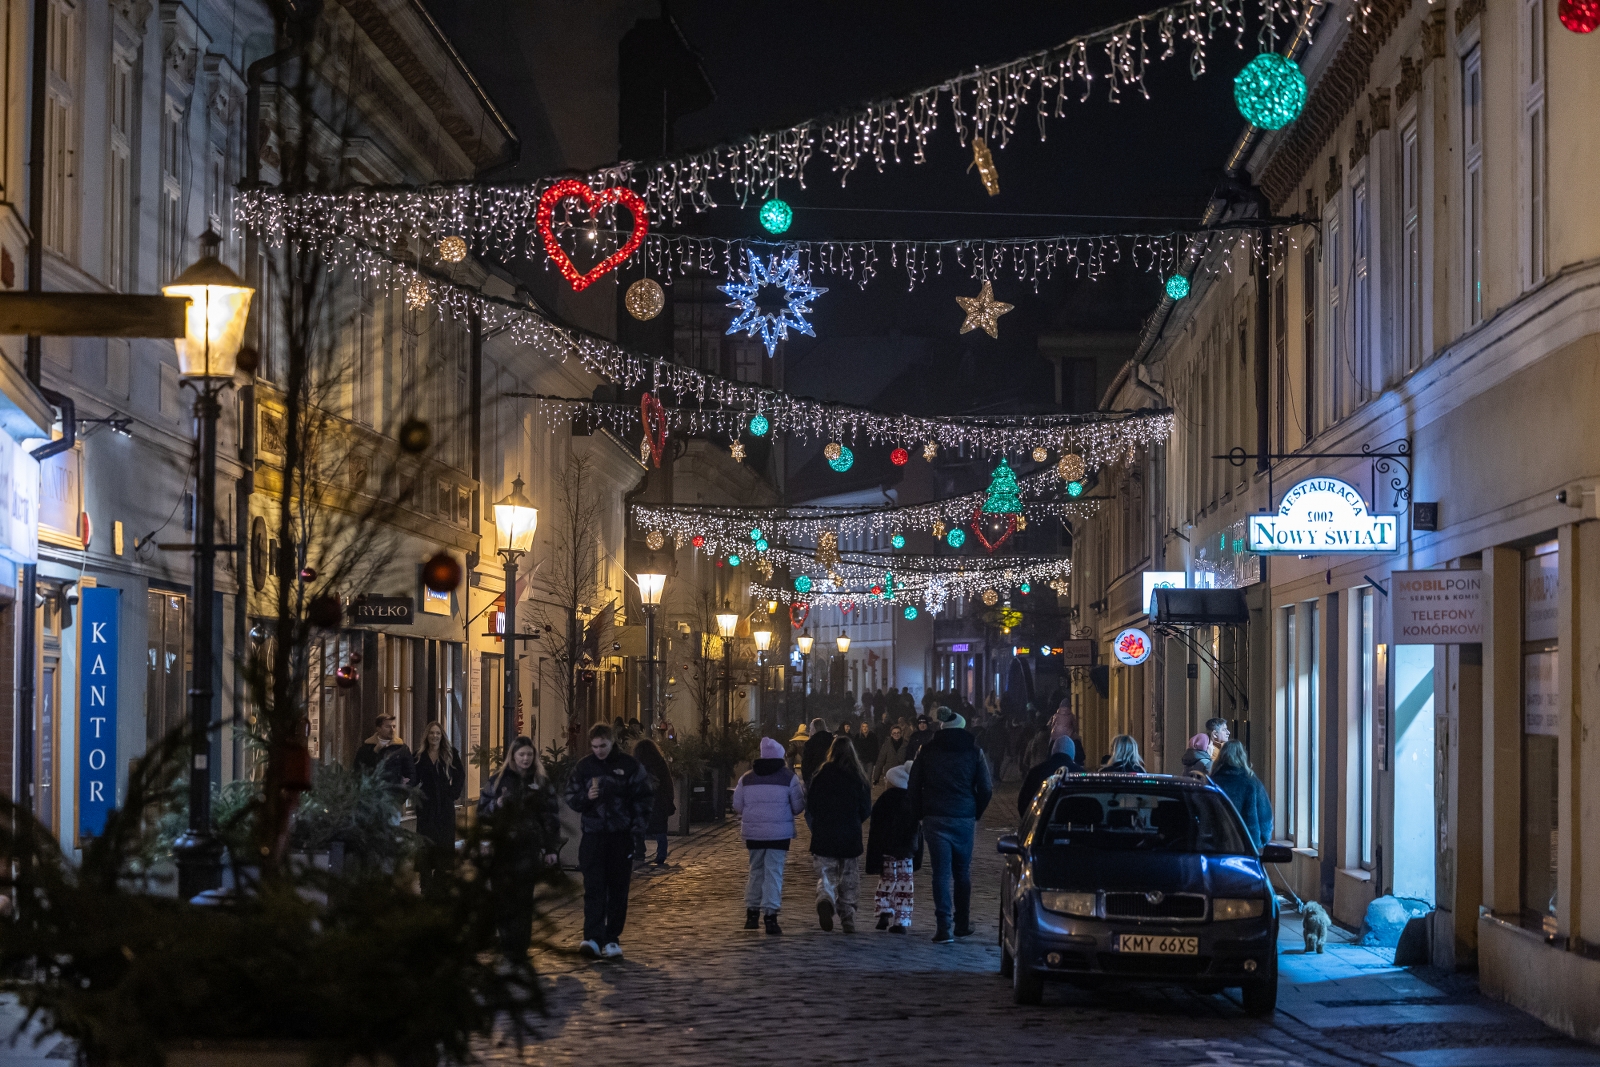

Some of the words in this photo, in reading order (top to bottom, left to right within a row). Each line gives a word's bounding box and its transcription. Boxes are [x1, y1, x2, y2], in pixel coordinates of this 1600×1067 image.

[1280, 481, 1362, 516] RESTAURACJA
[1307, 511, 1333, 522] 2002
[1255, 522, 1318, 545] NOWY
[1325, 522, 1392, 545] ŚWIAT
[358, 605, 408, 617] RYŁKO
[1411, 609, 1475, 621] TELEFONY
[89, 622, 107, 802] KANTOR
[1122, 936, 1154, 951] KMY
[1159, 937, 1196, 953] 66XS
